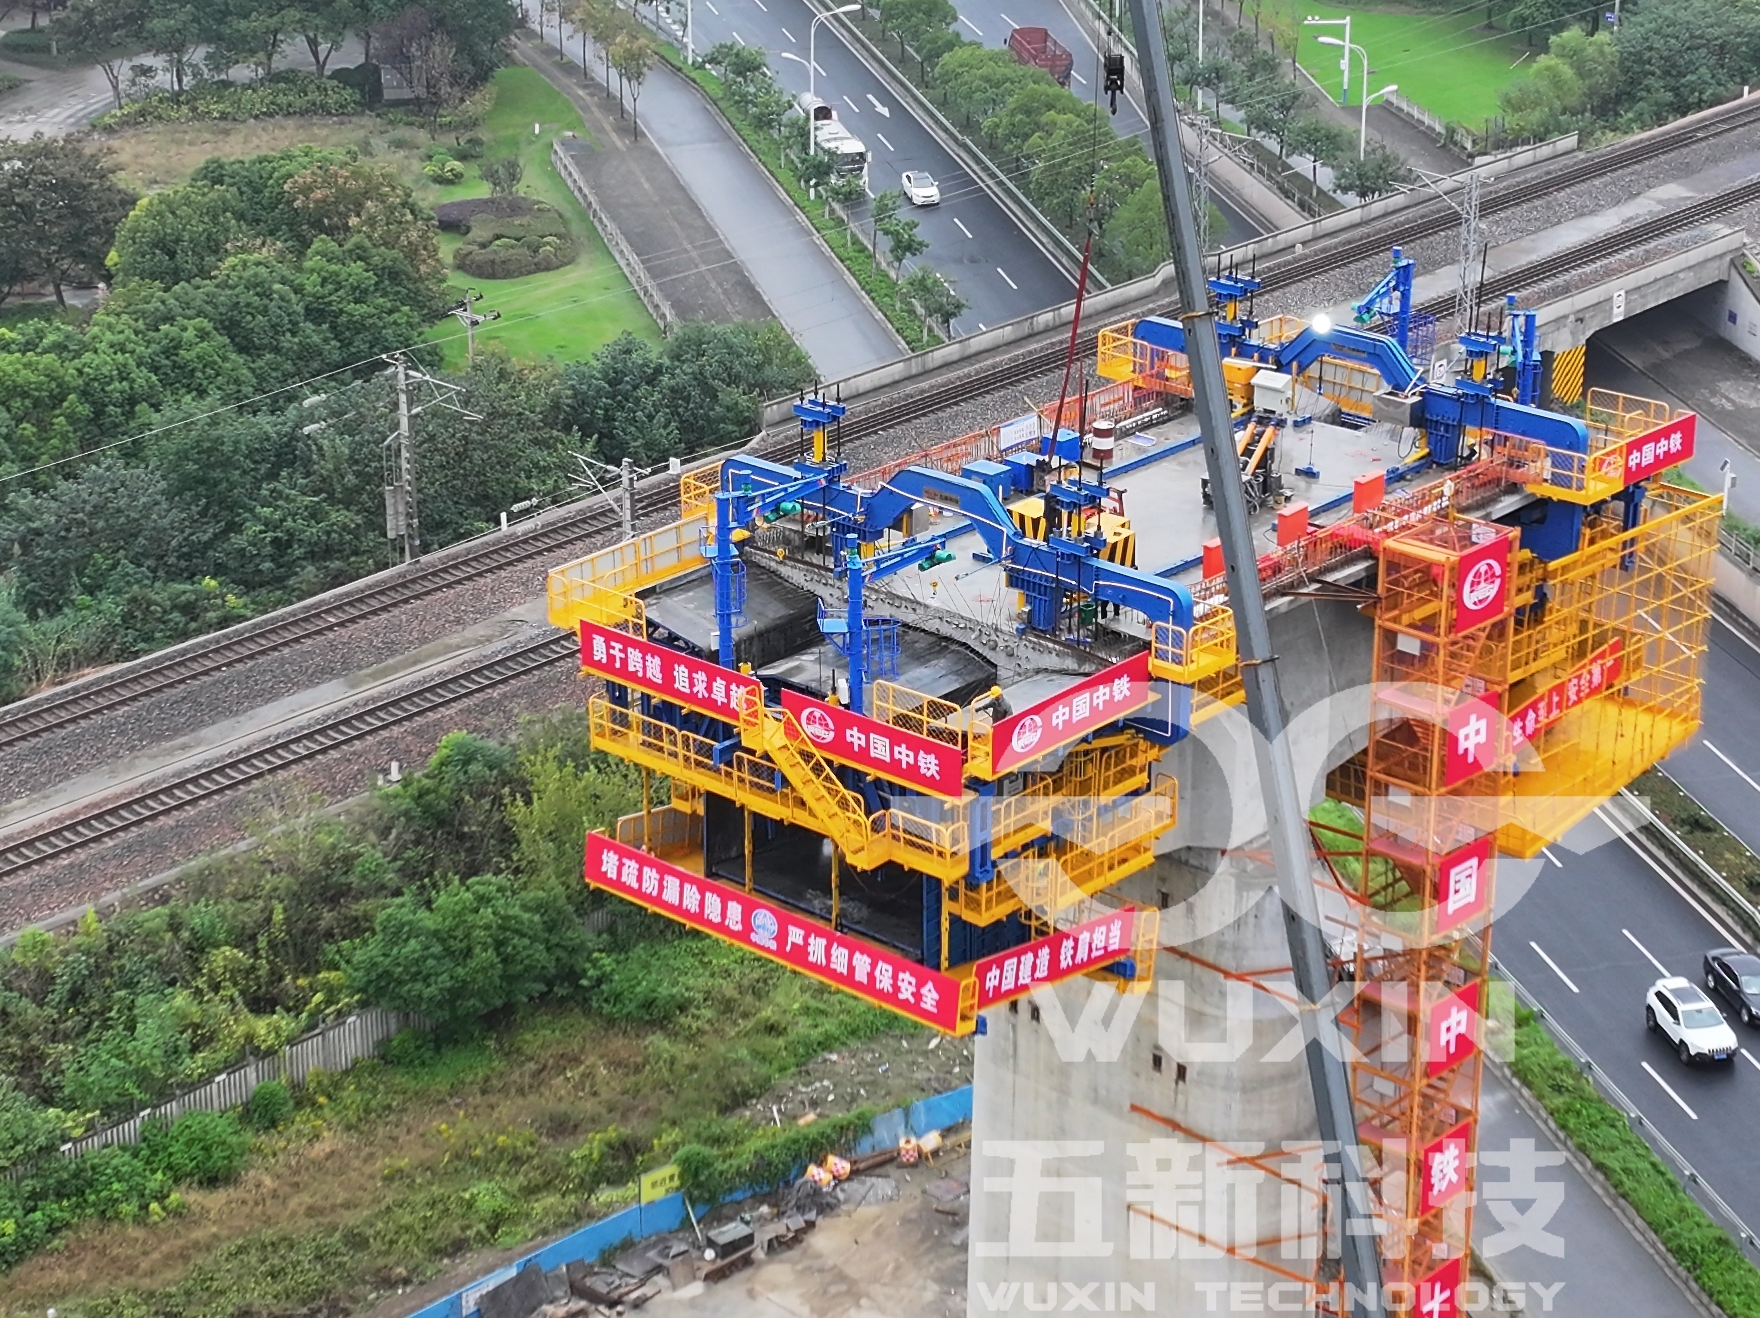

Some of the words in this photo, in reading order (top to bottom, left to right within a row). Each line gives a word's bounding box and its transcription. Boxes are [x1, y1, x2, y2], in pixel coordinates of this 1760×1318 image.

[1628, 431, 1682, 471] 中国中铁
[592, 633, 663, 684] 勇于跨越
[673, 663, 748, 712] 追求卓越
[1052, 674, 1131, 731] 中国中铁
[845, 727, 941, 782] 中国中铁
[601, 848, 742, 931] 堵疏防漏除隐患
[785, 924, 940, 1013] 严抓细管保安全
[985, 945, 1050, 998] 中国建造
[1060, 919, 1121, 970] 铁肩担当
